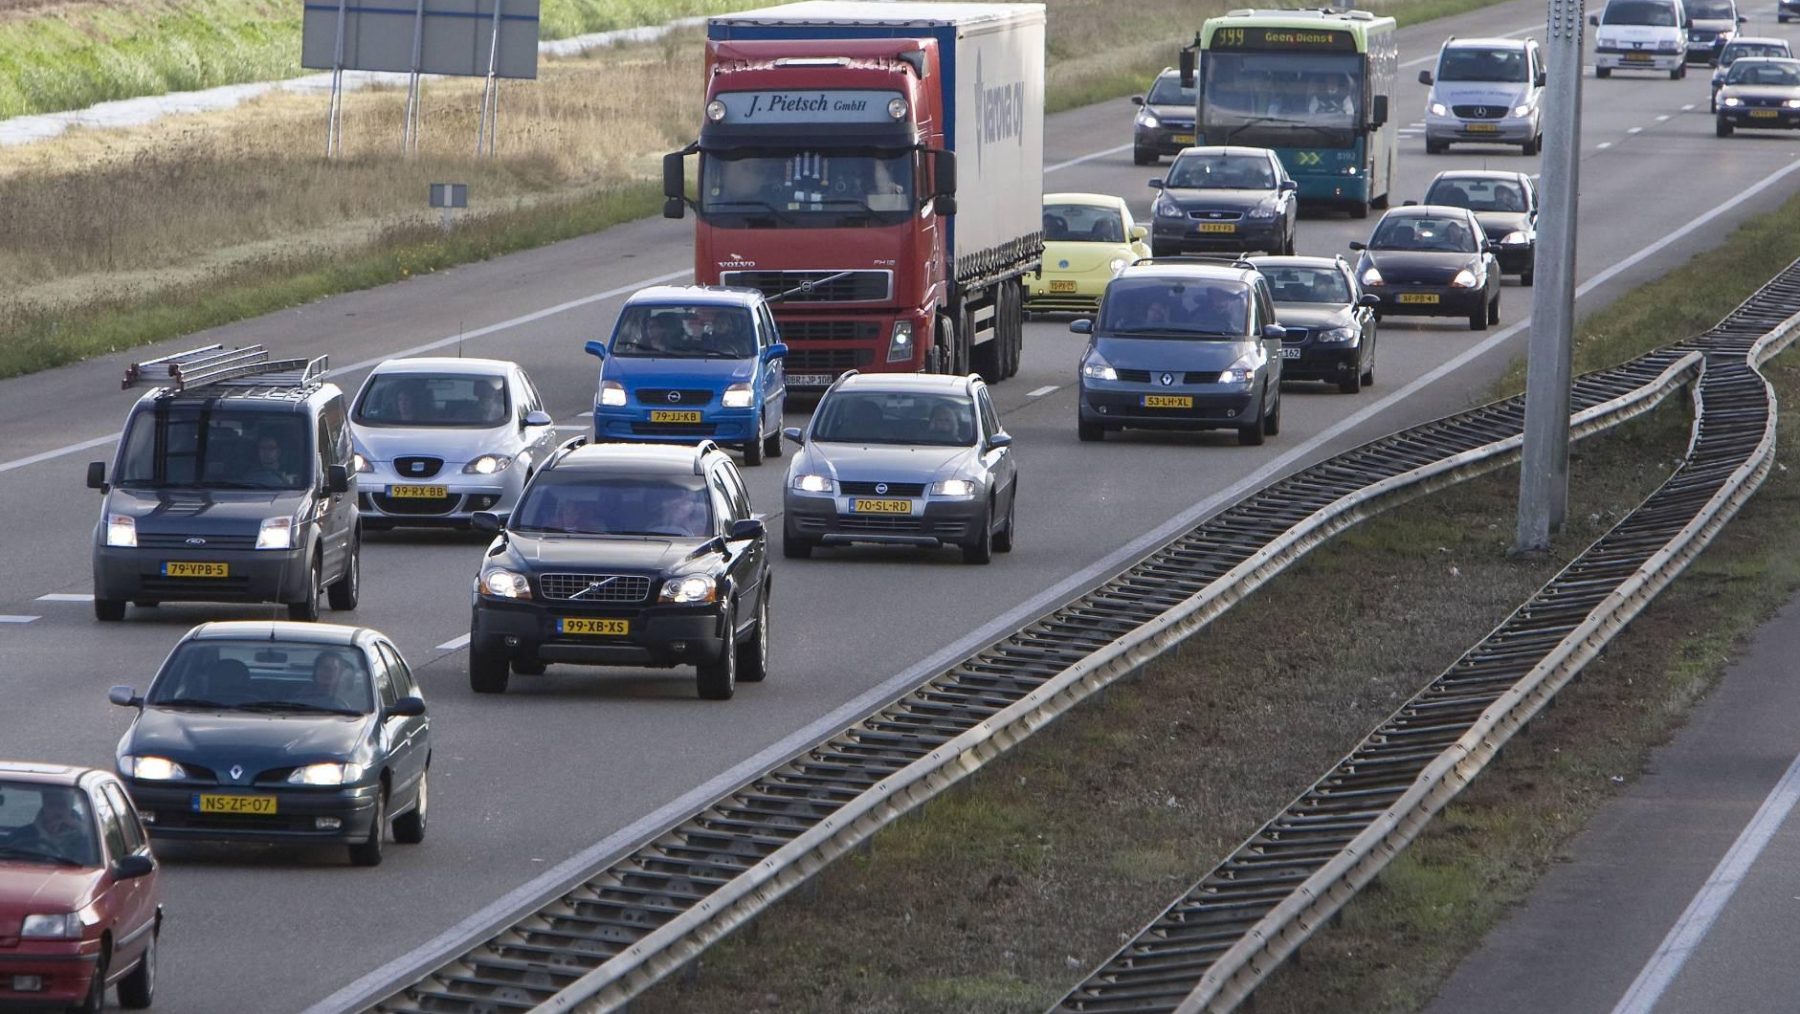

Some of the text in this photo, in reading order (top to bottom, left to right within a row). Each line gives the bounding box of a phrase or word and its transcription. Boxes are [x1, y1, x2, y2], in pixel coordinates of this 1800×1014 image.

[1265, 32, 1334, 43] Geen Dienst
[744, 94, 868, 119] J. Pietsch GmbH
[1147, 397, 1189, 406] 53-LH-XL
[655, 412, 697, 421] 79-JJ-KB
[394, 487, 444, 497] 99-RX-BB
[858, 501, 908, 511] 70-SL-RD
[171, 563, 224, 575] 79-VPB-5
[567, 620, 624, 633] 99-XB-XS
[206, 796, 271, 812] NS-ZF-07
